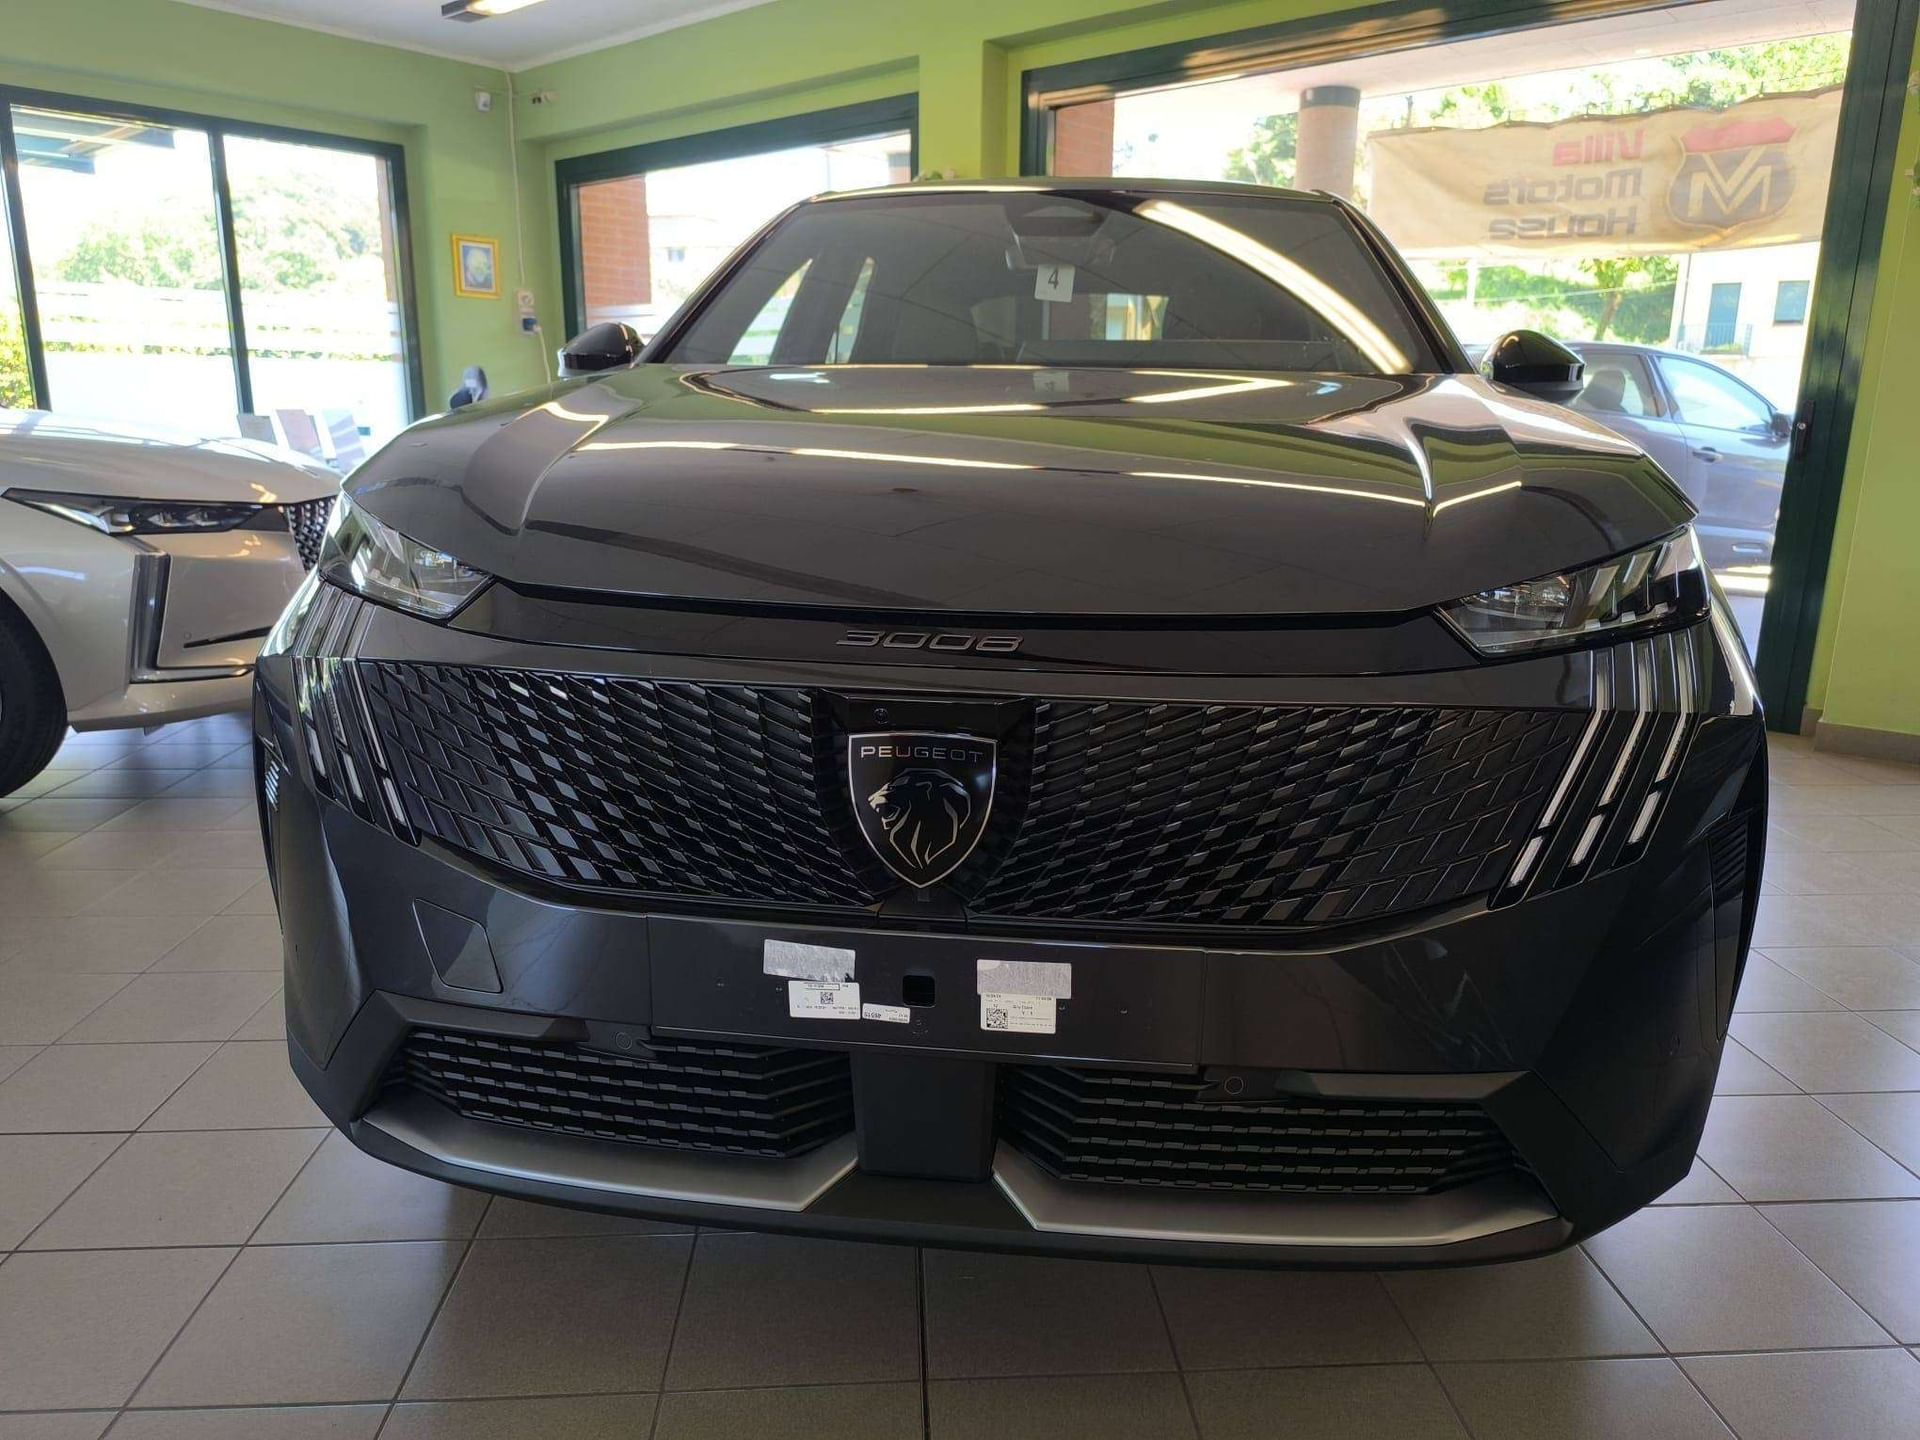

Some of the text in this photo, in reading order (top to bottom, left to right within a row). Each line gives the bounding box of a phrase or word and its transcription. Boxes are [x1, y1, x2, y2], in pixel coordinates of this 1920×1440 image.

[1047, 268, 1059, 290] 4
[836, 630, 1024, 652] 3008
[861, 746, 983, 763] PEUGEOT
